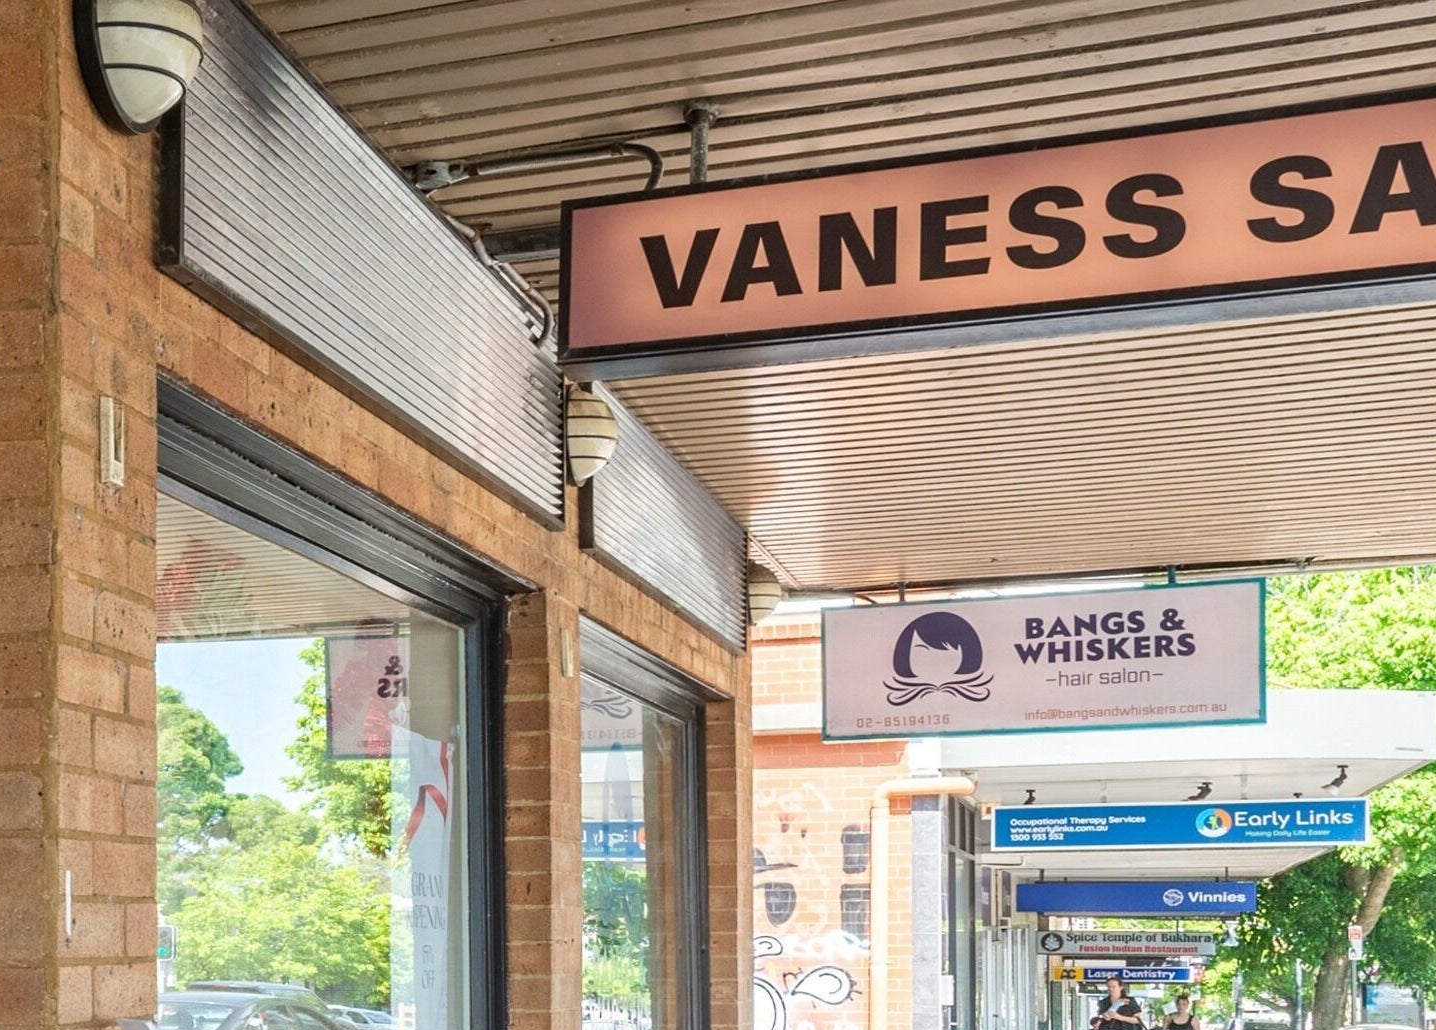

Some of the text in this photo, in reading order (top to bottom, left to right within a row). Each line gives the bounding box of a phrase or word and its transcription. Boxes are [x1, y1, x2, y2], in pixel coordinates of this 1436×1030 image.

[639, 172, 1188, 309] VANESS
[1025, 608, 1186, 640] BANGS &
[1013, 633, 1197, 664] WHISKERS
[1024, 702, 1228, 721] info@bangsandwhiskers.com.au
[856, 713, 951, 729] 02-85194136
[1010, 815, 1146, 827] Occupational Therapy Services
[1234, 809, 1354, 829] Early Links
[1010, 826, 1108, 835] www.earlylinks.com.au
[1010, 833, 1031, 841] 1300
[1188, 891, 1246, 903] Vinnies
[1066, 933, 1211, 944] Spice Temple of Bukhara
[1079, 945, 1198, 953] Fusion Indian Restaurant
[1088, 970, 1119, 980] Laser
[1123, 969, 1176, 980] Dentistry
